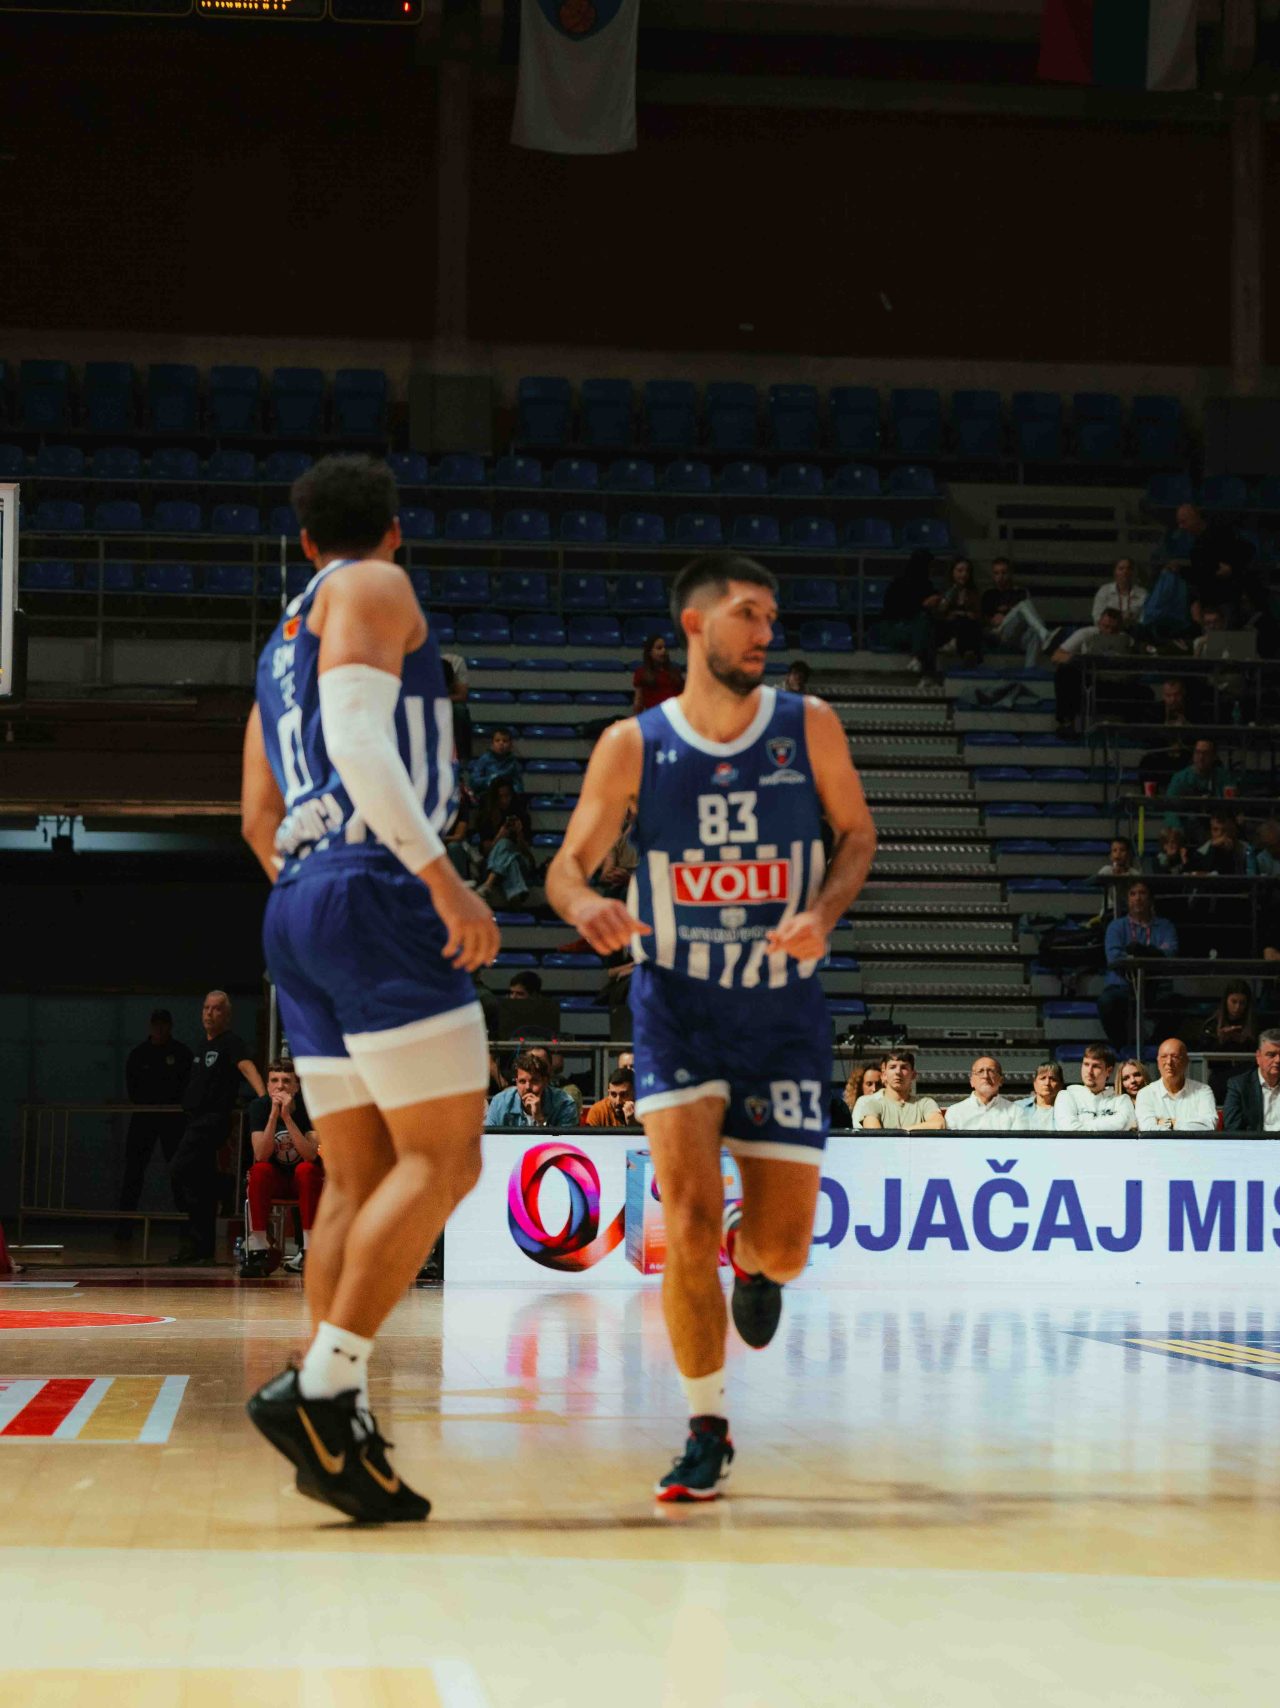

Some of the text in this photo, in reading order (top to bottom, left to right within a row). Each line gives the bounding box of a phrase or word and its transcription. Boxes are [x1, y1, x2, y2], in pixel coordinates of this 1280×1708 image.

[698, 791, 758, 846] 83
[681, 864, 781, 900] VOLI
[769, 1080, 823, 1131] 83
[812, 1159, 1142, 1253] OJAČAJ
